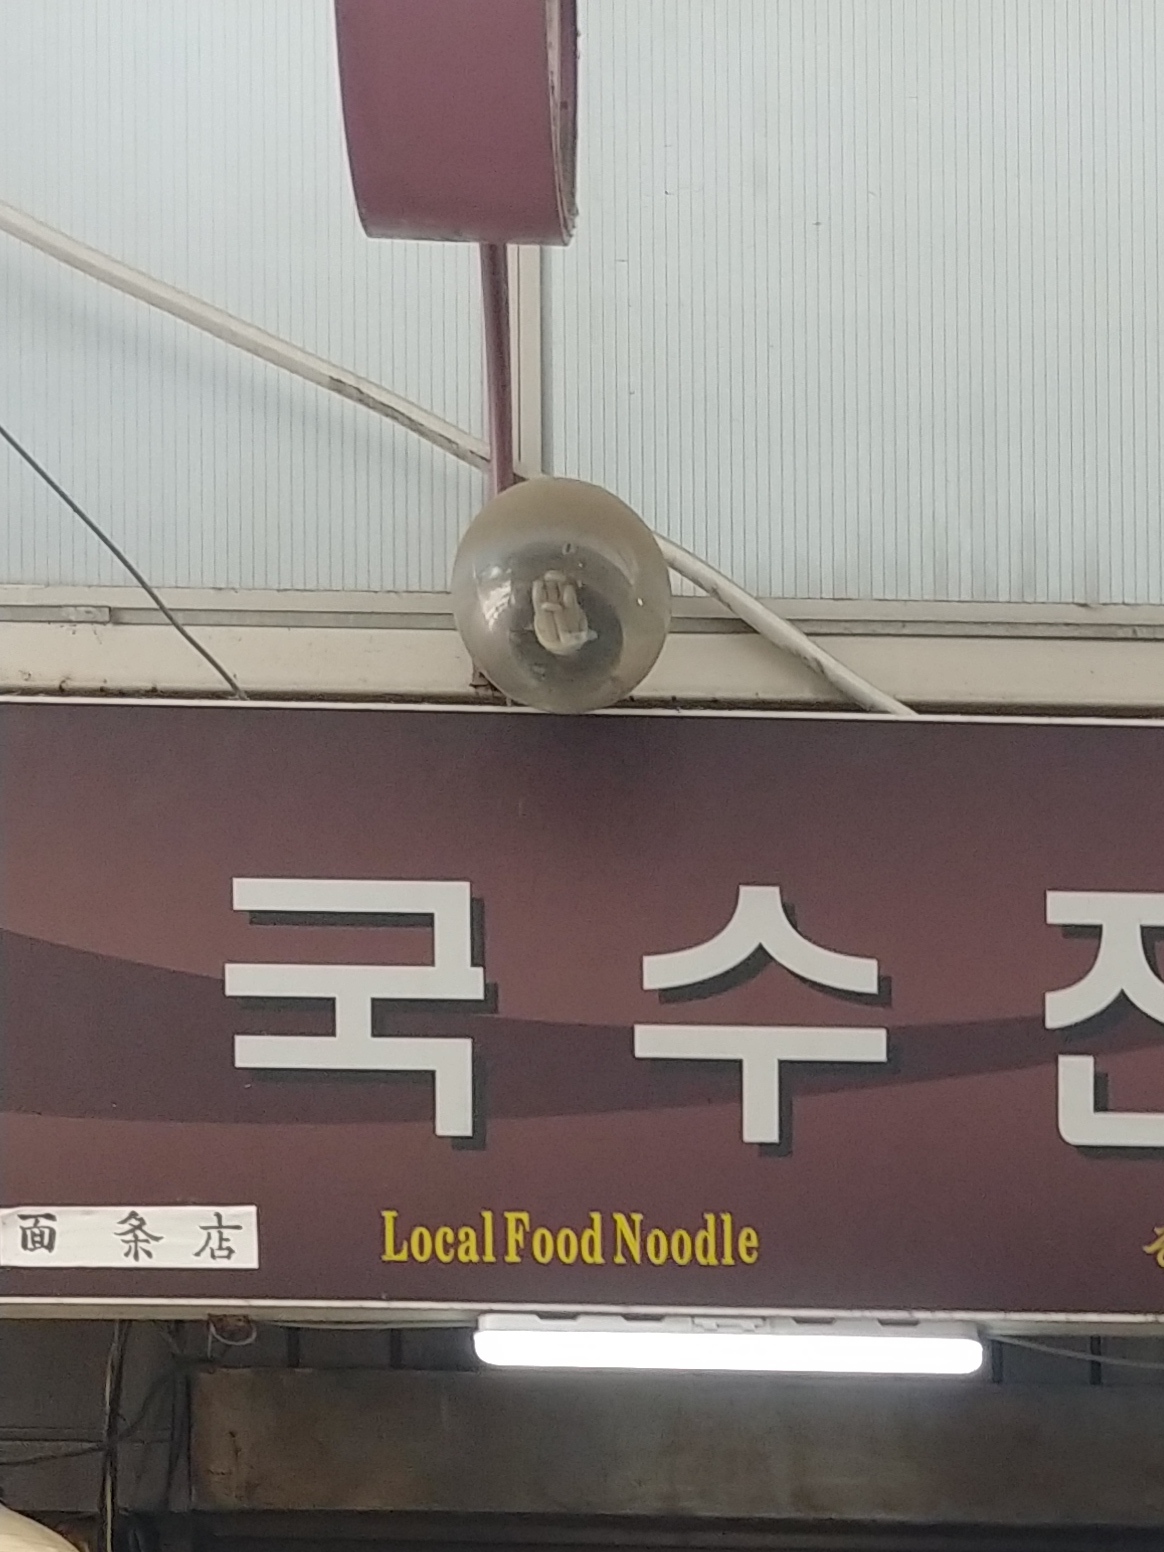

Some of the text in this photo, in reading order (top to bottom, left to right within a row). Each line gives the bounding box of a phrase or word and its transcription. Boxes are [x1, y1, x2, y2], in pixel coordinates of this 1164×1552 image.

[17, 1212, 243, 1263] 面条店
[381, 1210, 760, 1267] Local Food Noodle
